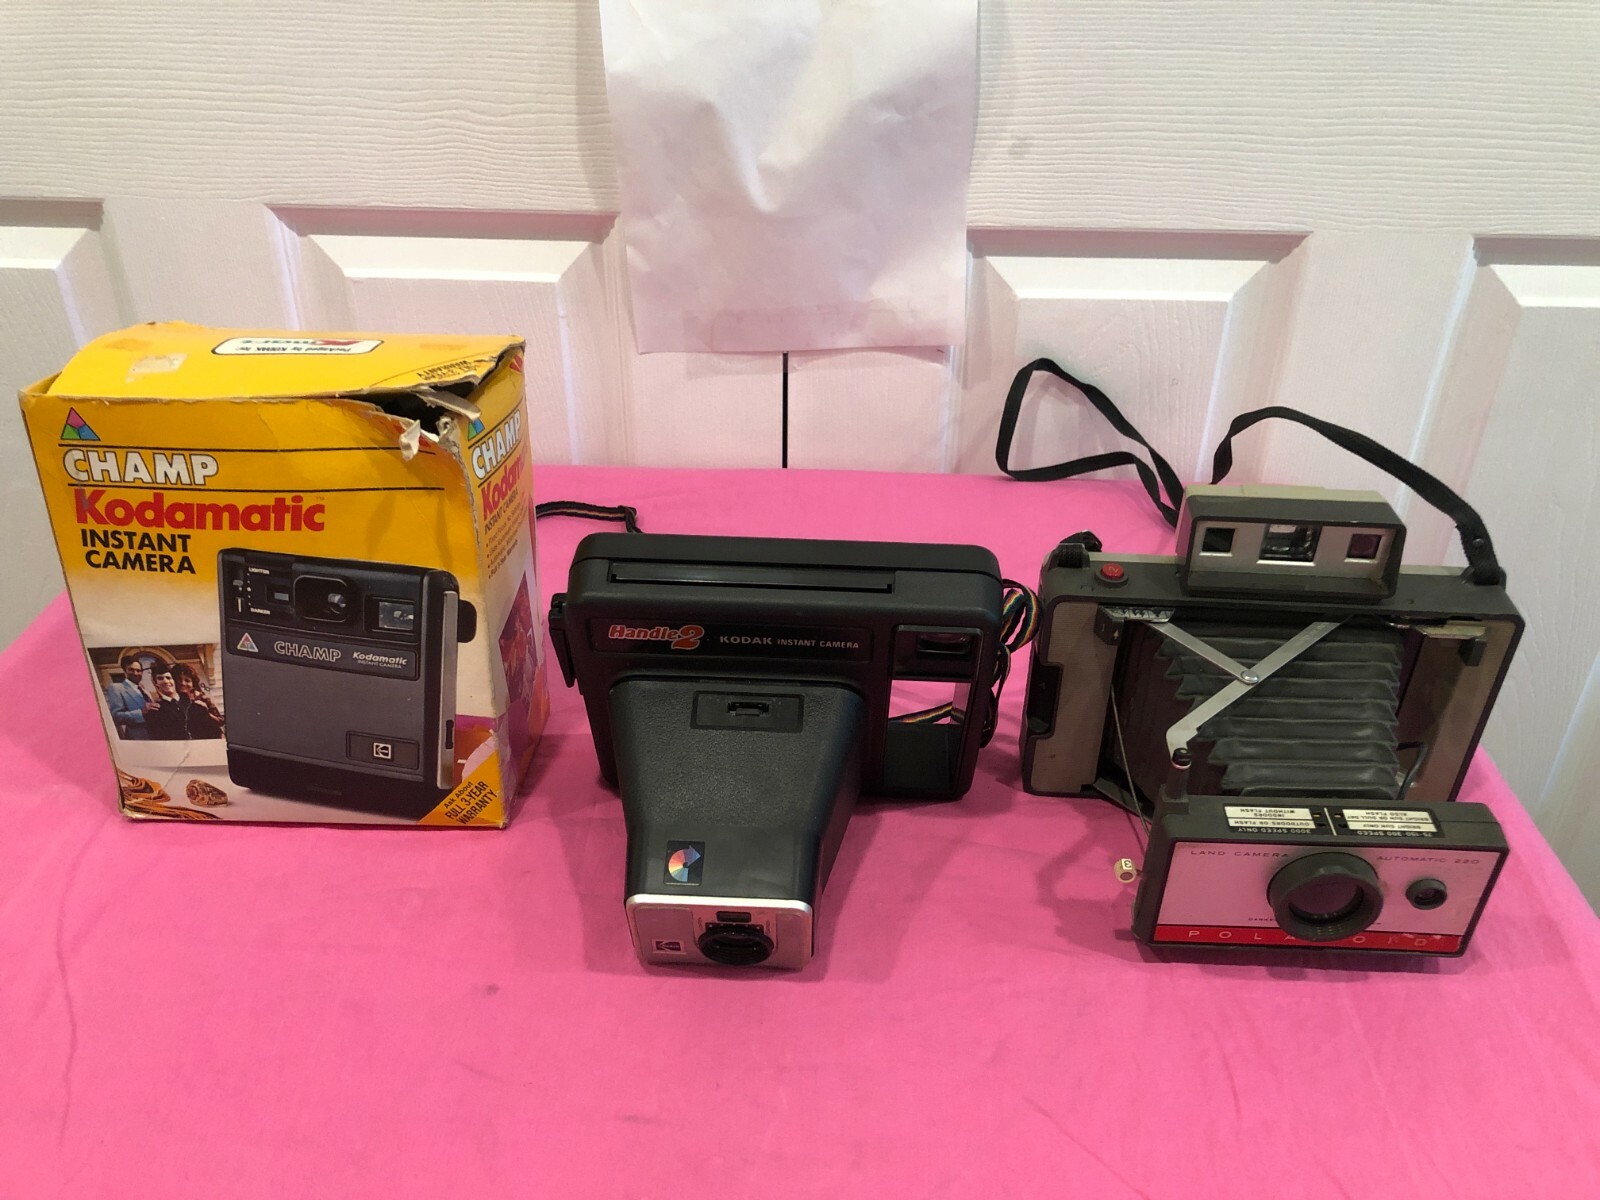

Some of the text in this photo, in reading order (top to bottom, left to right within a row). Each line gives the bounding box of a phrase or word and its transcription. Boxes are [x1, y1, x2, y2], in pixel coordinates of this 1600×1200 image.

[472, 409, 520, 480] CHAMP
[63, 449, 218, 486] CHAMP
[74, 489, 325, 531] Kodamatic
[80, 529, 191, 552] INSTANT
[85, 550, 196, 574] CAMERA
[274, 641, 342, 662] CHAMP
[720, 635, 859, 649] KODAK INSTANT CAMERA
[352, 651, 408, 665] Kodamatic
[444, 781, 473, 809] Ask About
[445, 781, 489, 820] FULL 3-YEAR
[456, 788, 498, 825] WARRANTY
